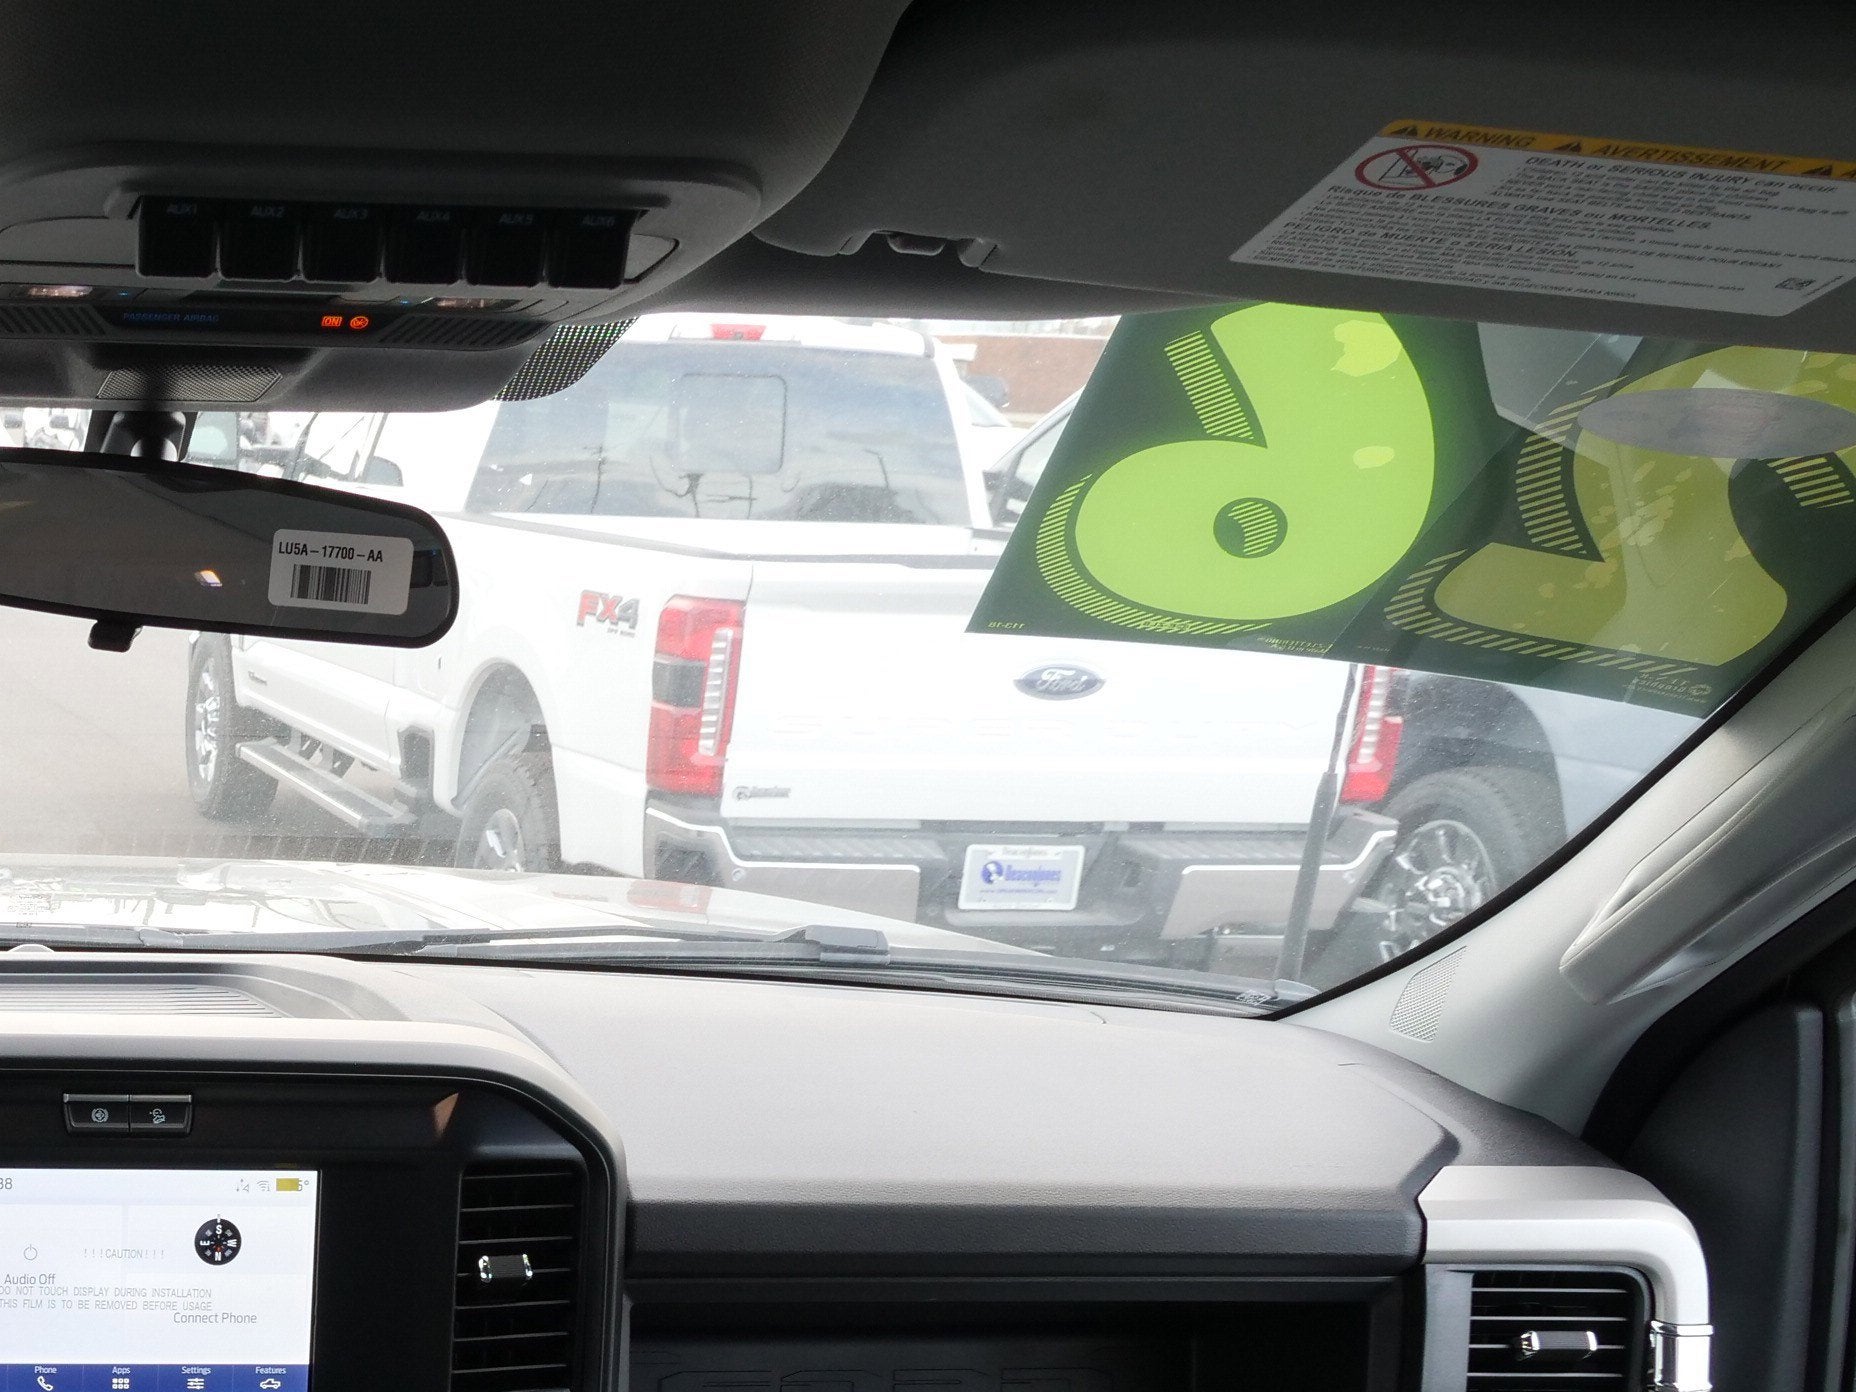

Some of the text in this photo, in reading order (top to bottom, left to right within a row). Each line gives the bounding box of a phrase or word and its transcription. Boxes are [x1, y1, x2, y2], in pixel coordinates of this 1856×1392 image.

[1423, 126, 1535, 148] WARNING
[1594, 144, 1790, 171] AVERTISSEMENT
[1525, 156, 1585, 169] DEATH
[1608, 165, 1685, 179] SERIOUS
[1689, 171, 1750, 183] INJURY
[122, 311, 181, 322] PASSENGER
[323, 317, 341, 327] ON
[576, 588, 641, 628] FX4
[215, 1224, 222, 1235] S
[214, 1251, 222, 1261] N
[4, 1273, 55, 1285] Audio Off
[16, 1286, 33, 1296] NOT
[39, 1287, 68, 1296] TOUCH
[74, 1287, 109, 1297] DISPLAY
[114, 1288, 147, 1297] DURING
[152, 1288, 212, 1298] INSTALLATION
[23, 1299, 42, 1309] FILM
[48, 1299, 56, 1309] IS
[61, 1299, 73, 1309] TO
[78, 1300, 90, 1310] BE
[94, 1300, 138, 1310] REMOVED
[143, 1301, 178, 1311] BEFORE
[183, 1301, 212, 1311] USAGE
[173, 1312, 257, 1324] Connect Phone
[34, 1365, 57, 1374] Phone
[112, 1365, 131, 1376] Apps
[181, 1365, 211, 1376] Settings
[255, 1365, 286, 1374] Features
